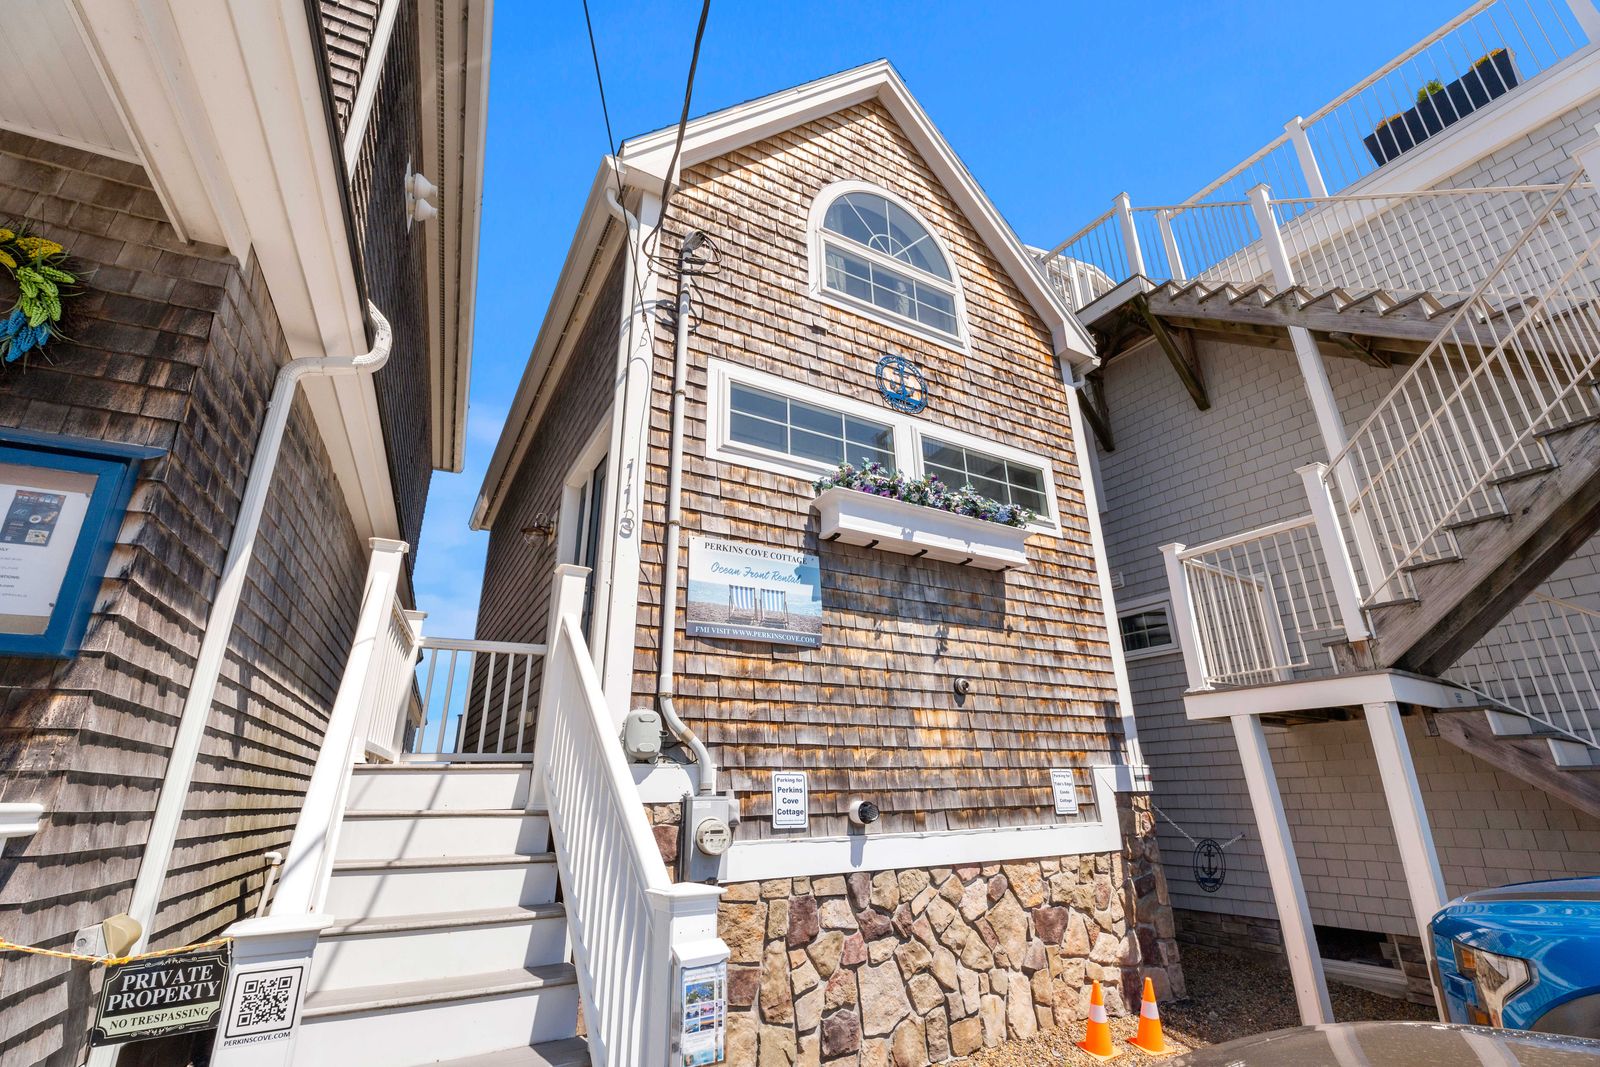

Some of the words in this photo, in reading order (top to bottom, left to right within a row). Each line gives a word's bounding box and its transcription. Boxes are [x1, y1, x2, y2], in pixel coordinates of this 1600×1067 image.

[704, 541, 744, 555] PERKINS
[744, 548, 769, 560] COVE
[770, 552, 807, 565] COTTAGE
[710, 562, 741, 576] Ocean
[743, 566, 769, 580] Front
[712, 628, 732, 636] VISIT
[732, 630, 816, 644] WWW.PERKINSCOVE.COM
[778, 808, 804, 816] Cottage
[120, 964, 213, 992] PRIVATE
[106, 980, 220, 1012] PROPERTY
[110, 1020, 128, 1030] NO
[130, 1006, 209, 1026] TRESPASSING
[223, 1032, 291, 1047] PERKINSCOVE.COM
